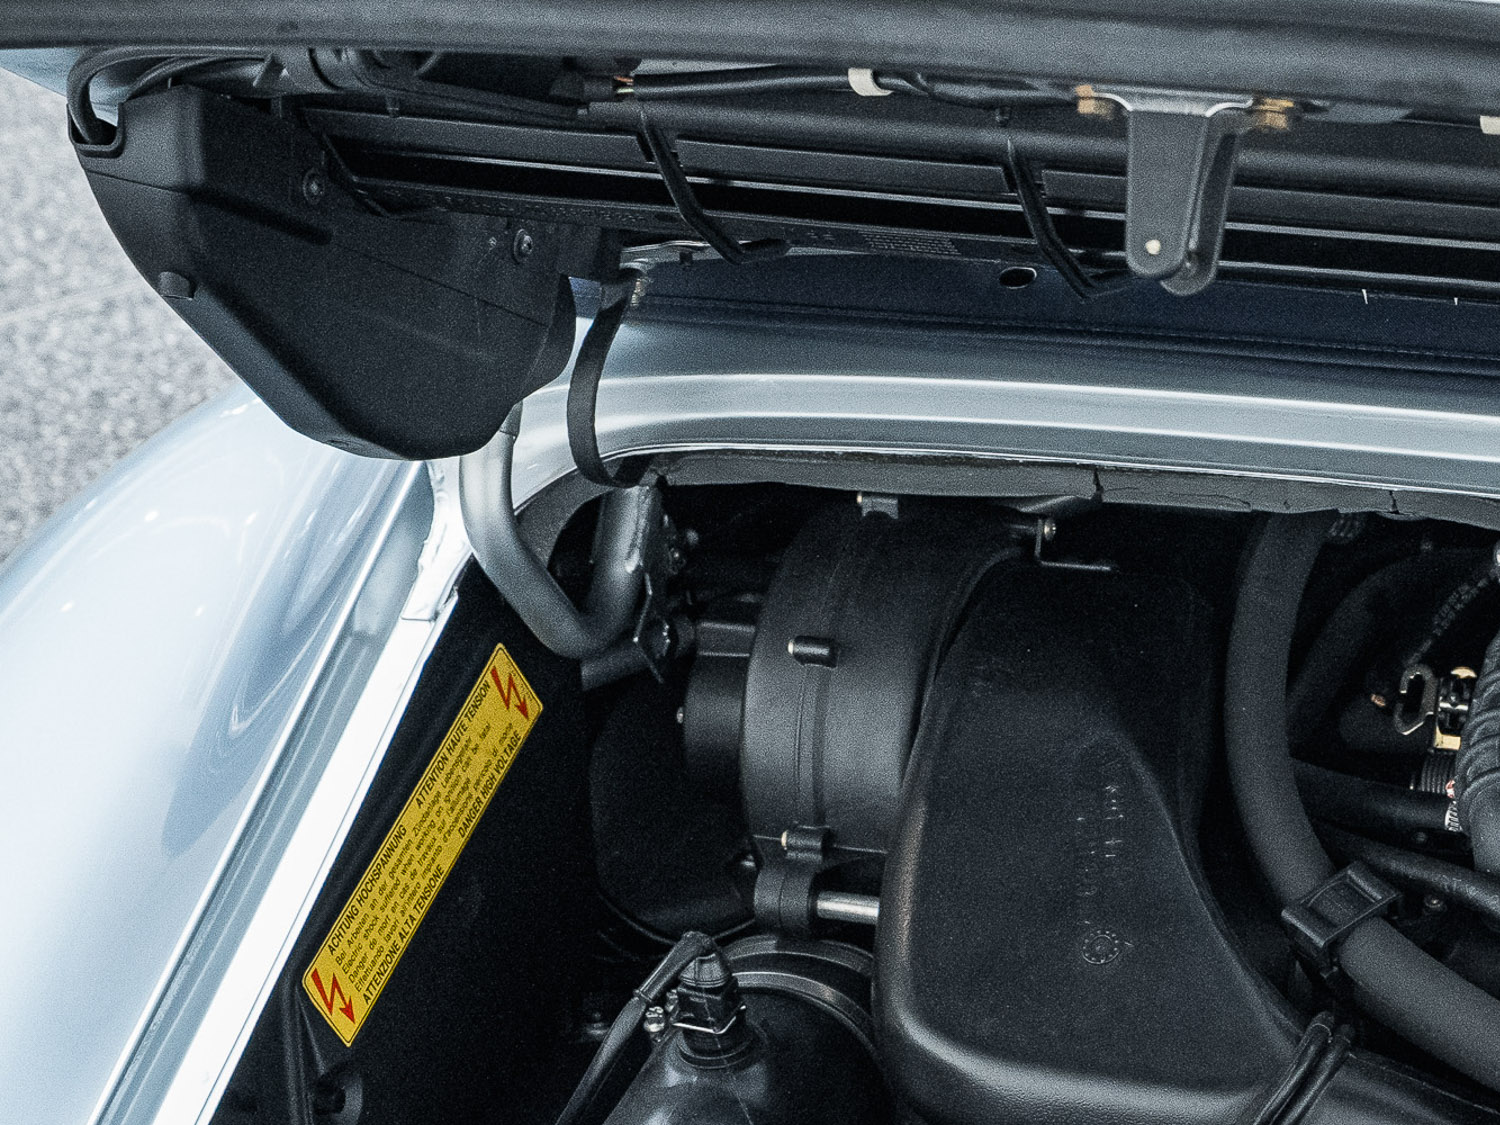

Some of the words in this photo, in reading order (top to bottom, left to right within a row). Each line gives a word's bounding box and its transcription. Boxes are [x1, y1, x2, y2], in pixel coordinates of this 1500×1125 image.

[414, 750, 449, 809] ATTENTION
[445, 719, 467, 756] HAUTE
[463, 678, 491, 725] TENSION
[457, 794, 483, 839] DANGER
[479, 771, 497, 800] HIGH
[492, 728, 521, 777] VOLTAGE
[326, 901, 360, 957] ACHTUNG
[355, 820, 407, 908] HOCHSPANNUNG
[361, 938, 401, 1005] ATTENZIONE
[397, 911, 416, 944] ALTA
[412, 862, 444, 916] TENSIONE
